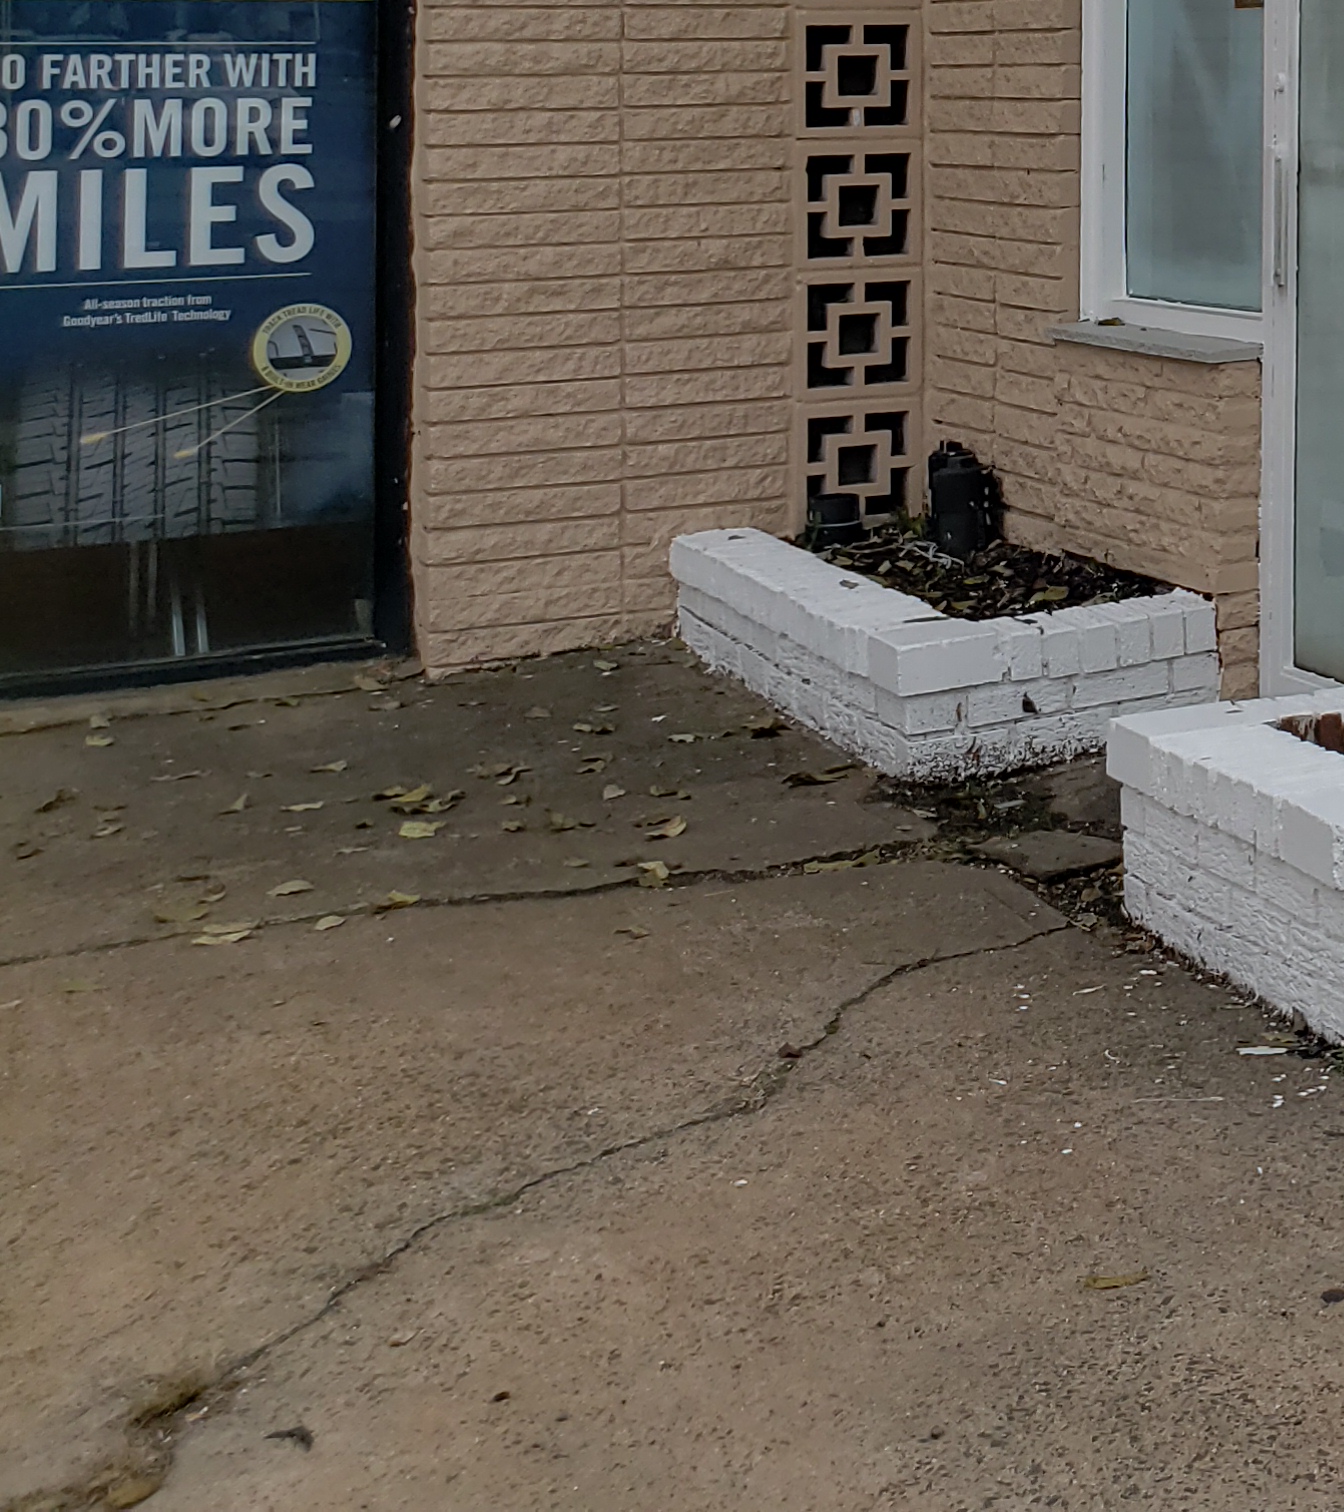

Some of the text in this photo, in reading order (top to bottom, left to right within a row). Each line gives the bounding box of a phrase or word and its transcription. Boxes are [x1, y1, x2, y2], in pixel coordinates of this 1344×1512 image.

[42, 53, 212, 90] FARTHER
[224, 53, 317, 88] WITH
[132, 97, 314, 159] MORE
[0, 163, 316, 274] MILES
[63, 312, 123, 328] Goodyear's
[172, 308, 232, 322] Technology
[84, 294, 212, 310] All-season traction from
